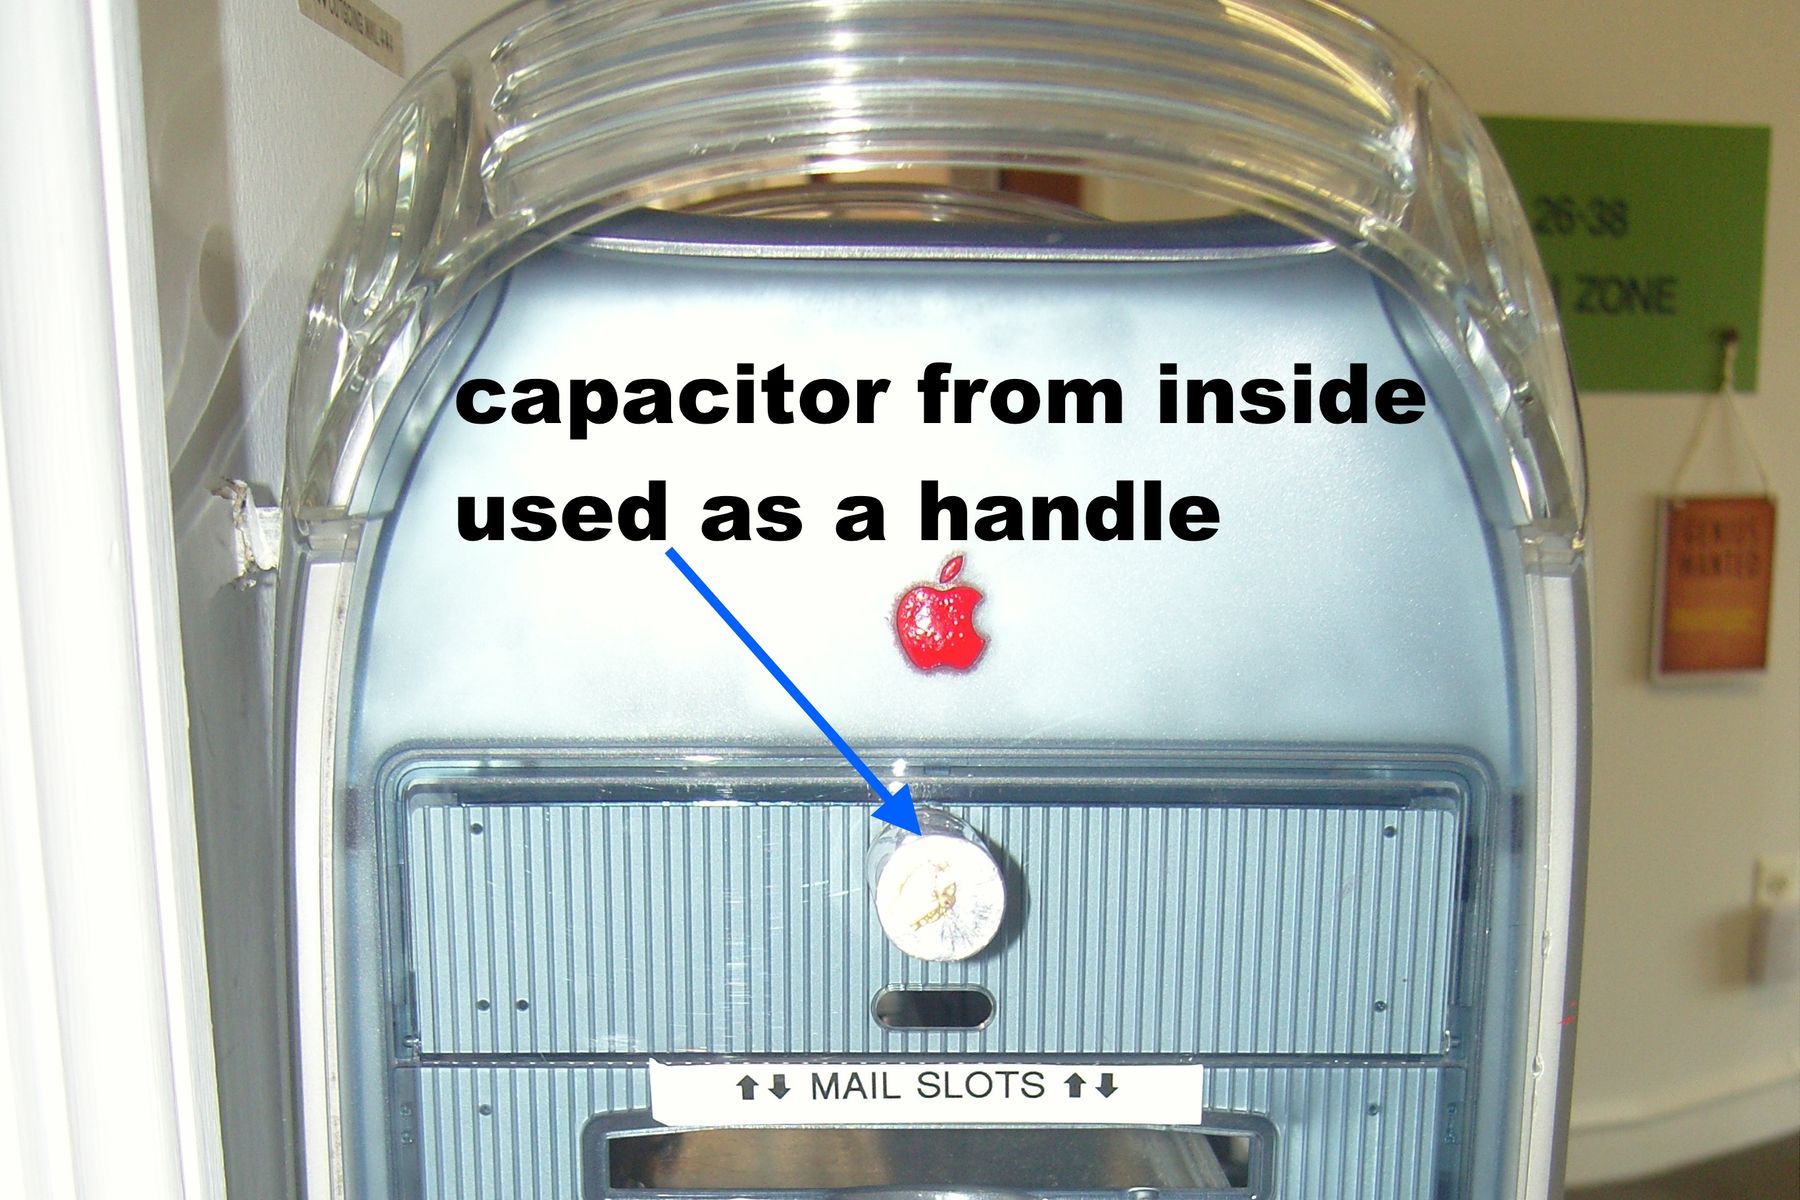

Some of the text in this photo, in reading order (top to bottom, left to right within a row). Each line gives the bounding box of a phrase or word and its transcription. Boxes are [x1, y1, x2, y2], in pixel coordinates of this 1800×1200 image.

[1573, 272, 1679, 315] ZONE
[811, 1071, 1045, 1100] MAIL SLOTS
